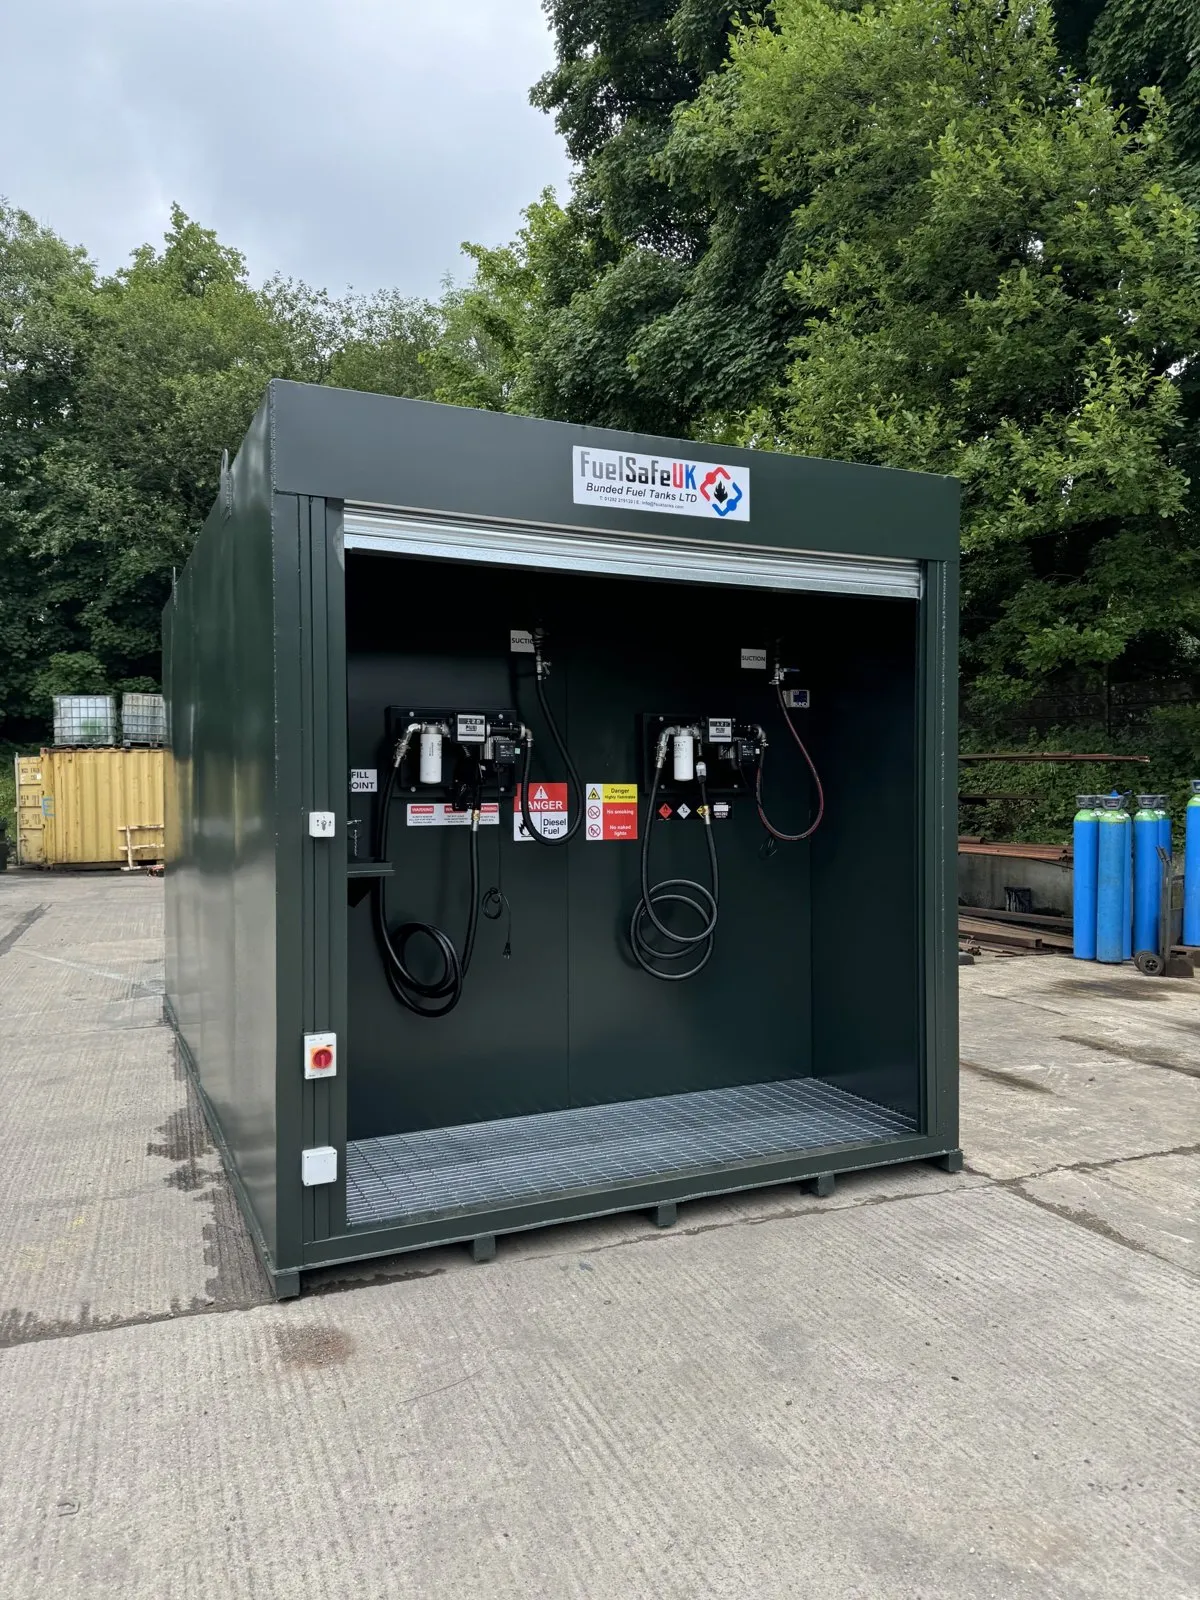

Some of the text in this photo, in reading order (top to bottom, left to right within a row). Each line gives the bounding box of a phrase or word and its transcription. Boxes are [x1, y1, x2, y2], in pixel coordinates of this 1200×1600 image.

[586, 482, 698, 503] Bunded Fuel Tanks LTD
[511, 637, 534, 645] SUCTIO
[351, 771, 369, 779] FILL
[351, 781, 375, 790] OINT
[610, 787, 630, 795] Danger
[519, 801, 563, 810] ANGER
[543, 818, 567, 827] Diesel
[543, 827, 560, 835] Fuel
